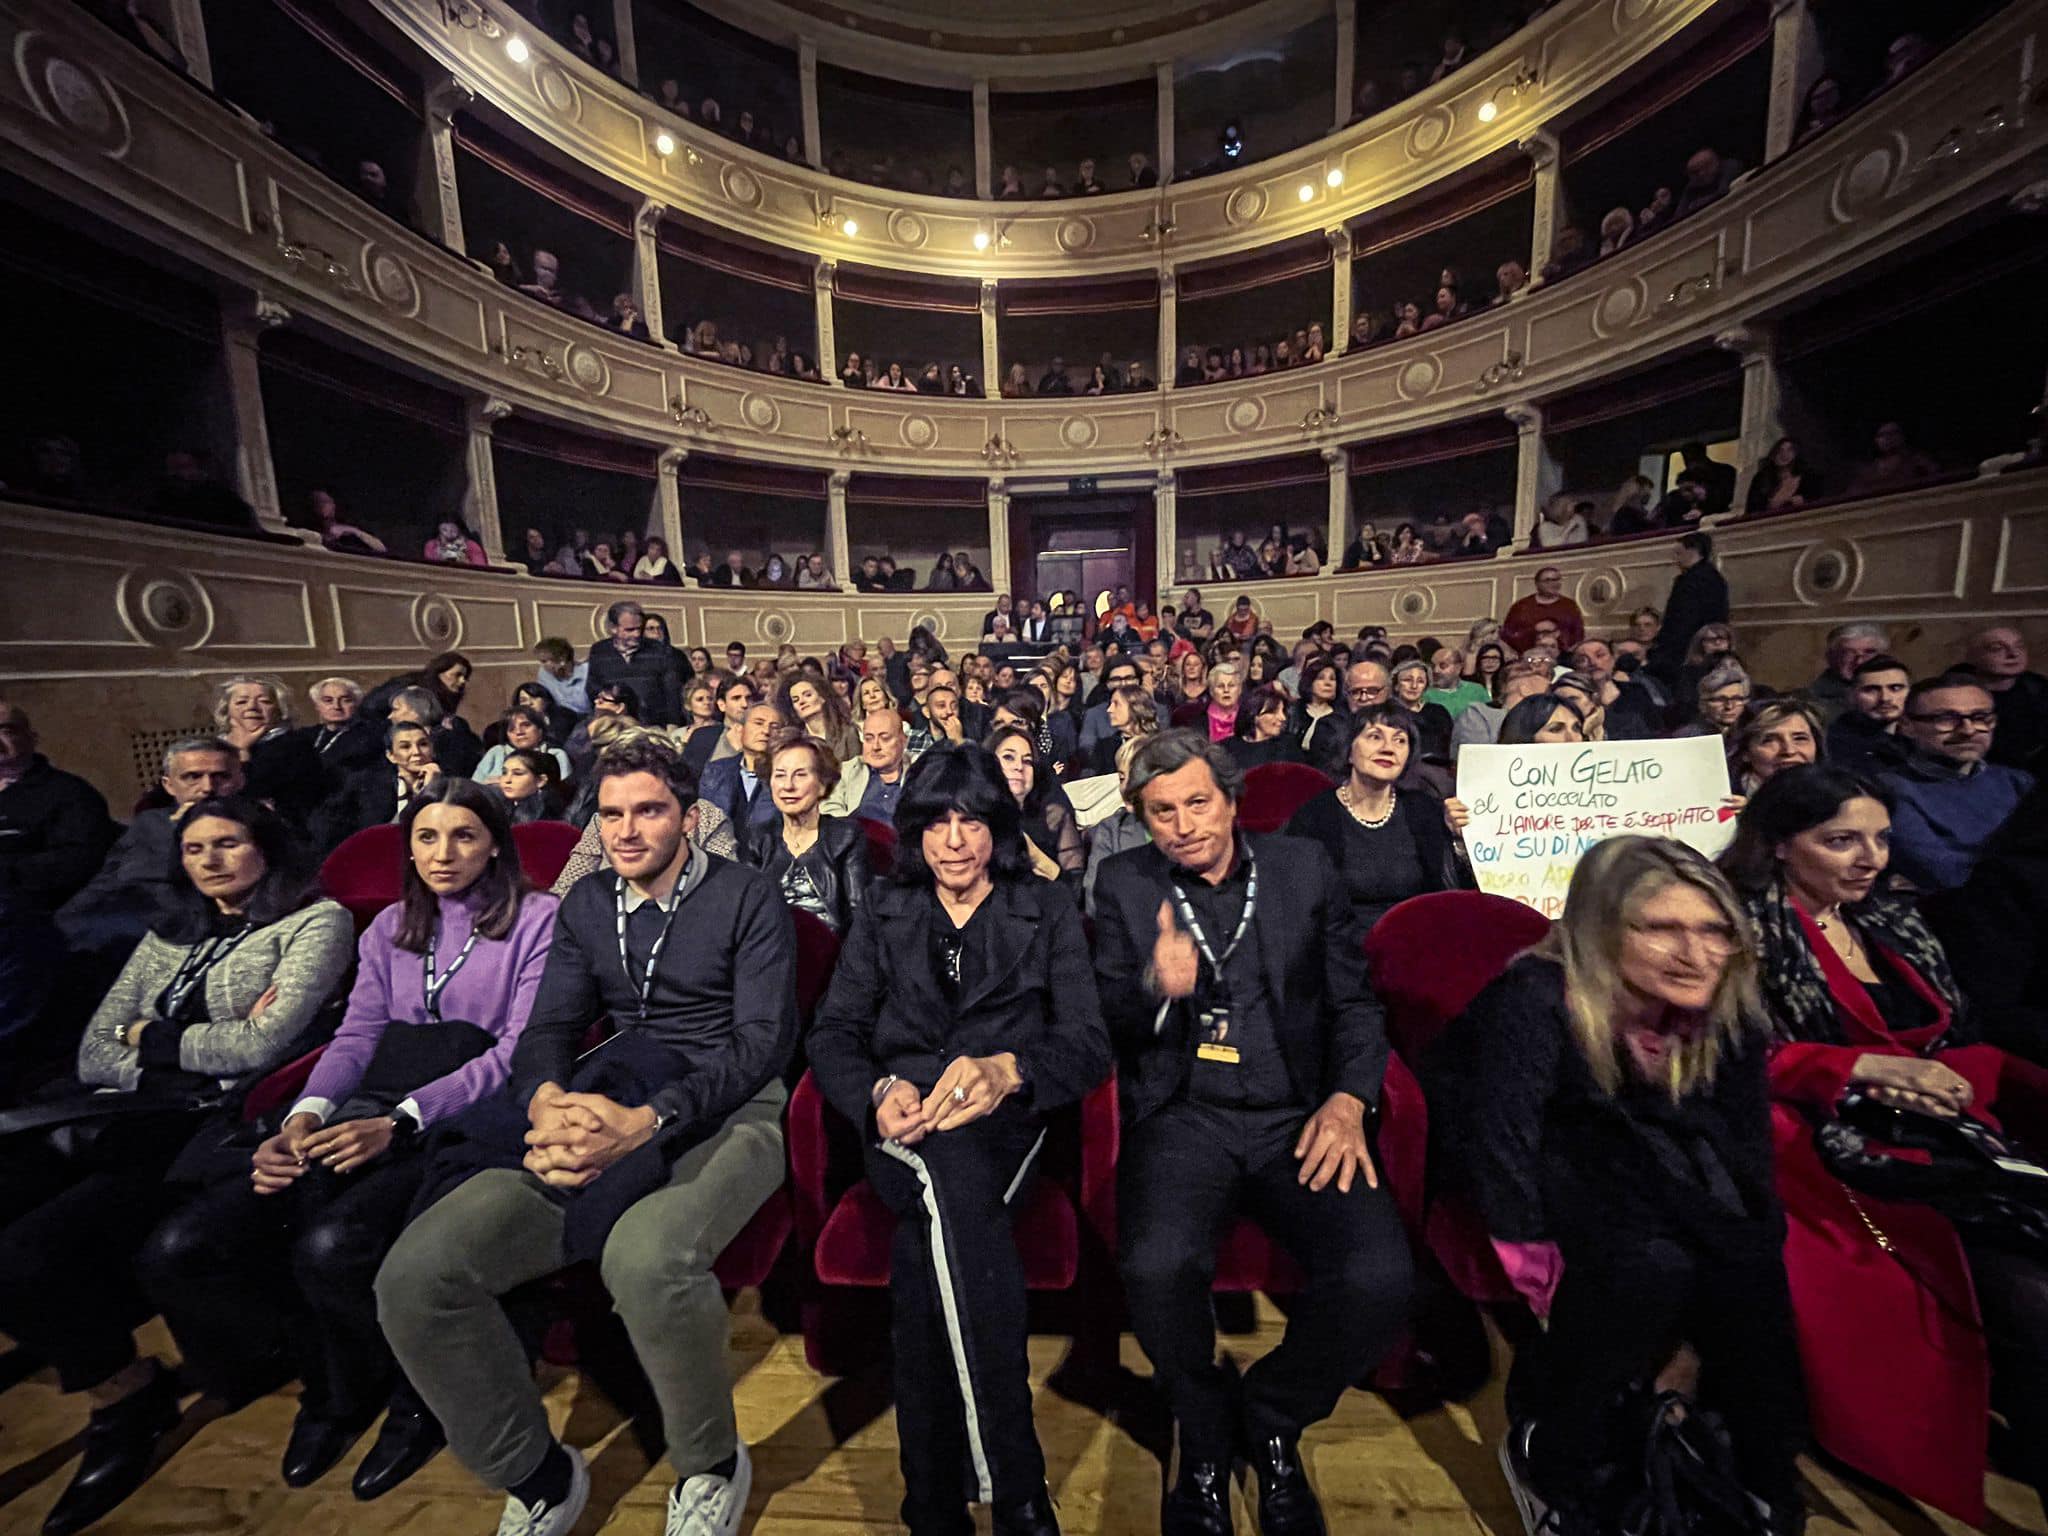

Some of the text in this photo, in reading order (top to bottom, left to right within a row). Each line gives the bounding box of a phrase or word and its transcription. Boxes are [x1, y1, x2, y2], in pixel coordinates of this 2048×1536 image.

[1570, 749, 1663, 795] GELATO
[1594, 814, 1620, 829] TE
[1514, 837, 1547, 859] SU
